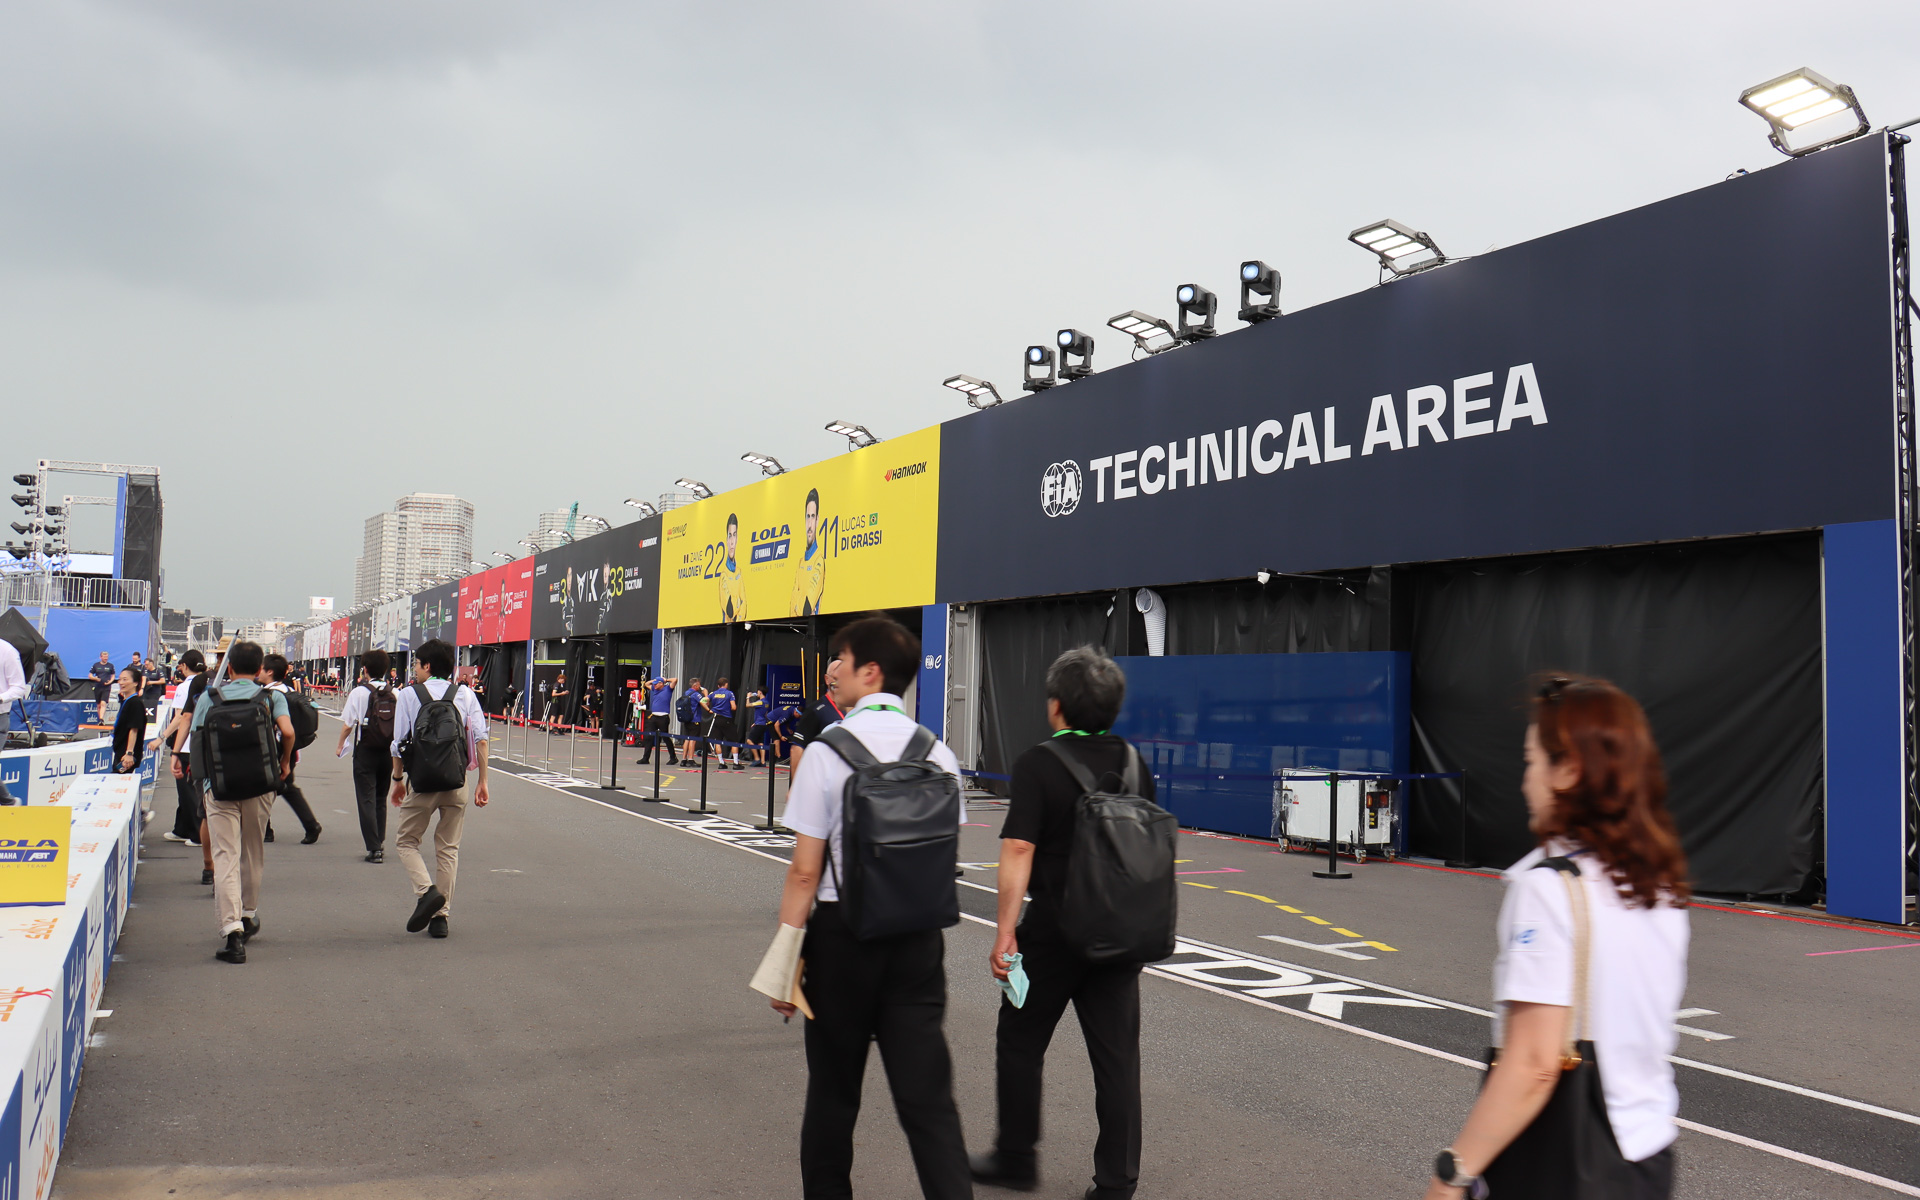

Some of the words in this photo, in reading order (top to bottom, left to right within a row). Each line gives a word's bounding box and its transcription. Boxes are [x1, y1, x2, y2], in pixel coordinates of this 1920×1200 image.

[1090, 406, 1352, 503] TECHNICAL
[1361, 362, 1548, 456] AREA
[751, 524, 791, 543] LOLA
[819, 515, 838, 559] 11
[842, 514, 866, 532] LUCAS
[841, 536, 849, 551] DI
[851, 530, 882, 550] GRASSI
[704, 541, 726, 579] 22
[610, 566, 624, 597] 33
[678, 565, 702, 579] MALONEY
[560, 579, 567, 604] 3
[504, 592, 513, 614] 25
[0, 839, 59, 848] OLA
[28, 852, 50, 861] ABT
